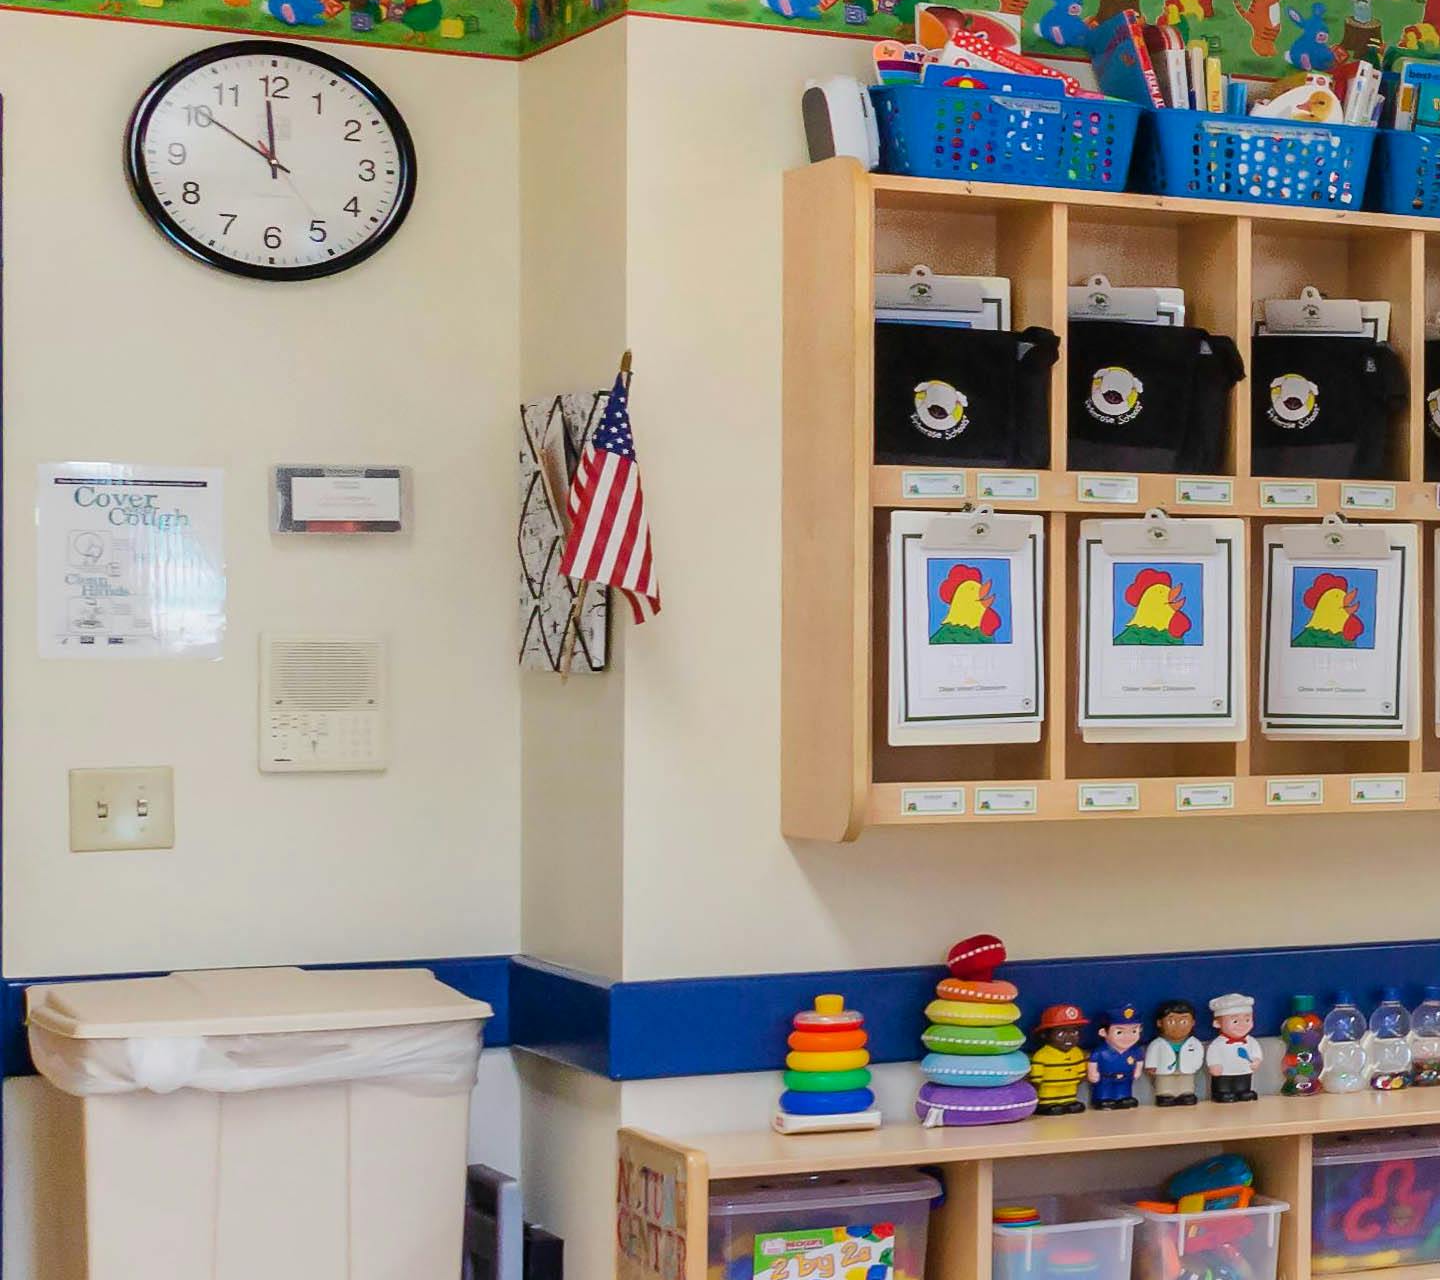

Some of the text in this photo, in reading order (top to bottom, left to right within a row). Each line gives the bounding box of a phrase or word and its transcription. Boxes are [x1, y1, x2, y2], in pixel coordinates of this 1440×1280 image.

[214, 83, 239, 106] 11
[259, 75, 289, 99] 12
[312, 92, 322, 115] 1
[183, 105, 213, 128] 10
[343, 119, 362, 142] 2
[167, 142, 187, 166] 9
[358, 159, 376, 182] 3
[182, 181, 200, 205] 8
[342, 196, 361, 217] 4
[218, 214, 237, 235] 7
[309, 220, 327, 243] 5
[263, 227, 282, 249] 6
[74, 486, 158, 508] Cover
[796, 1252, 834, 1277] by
